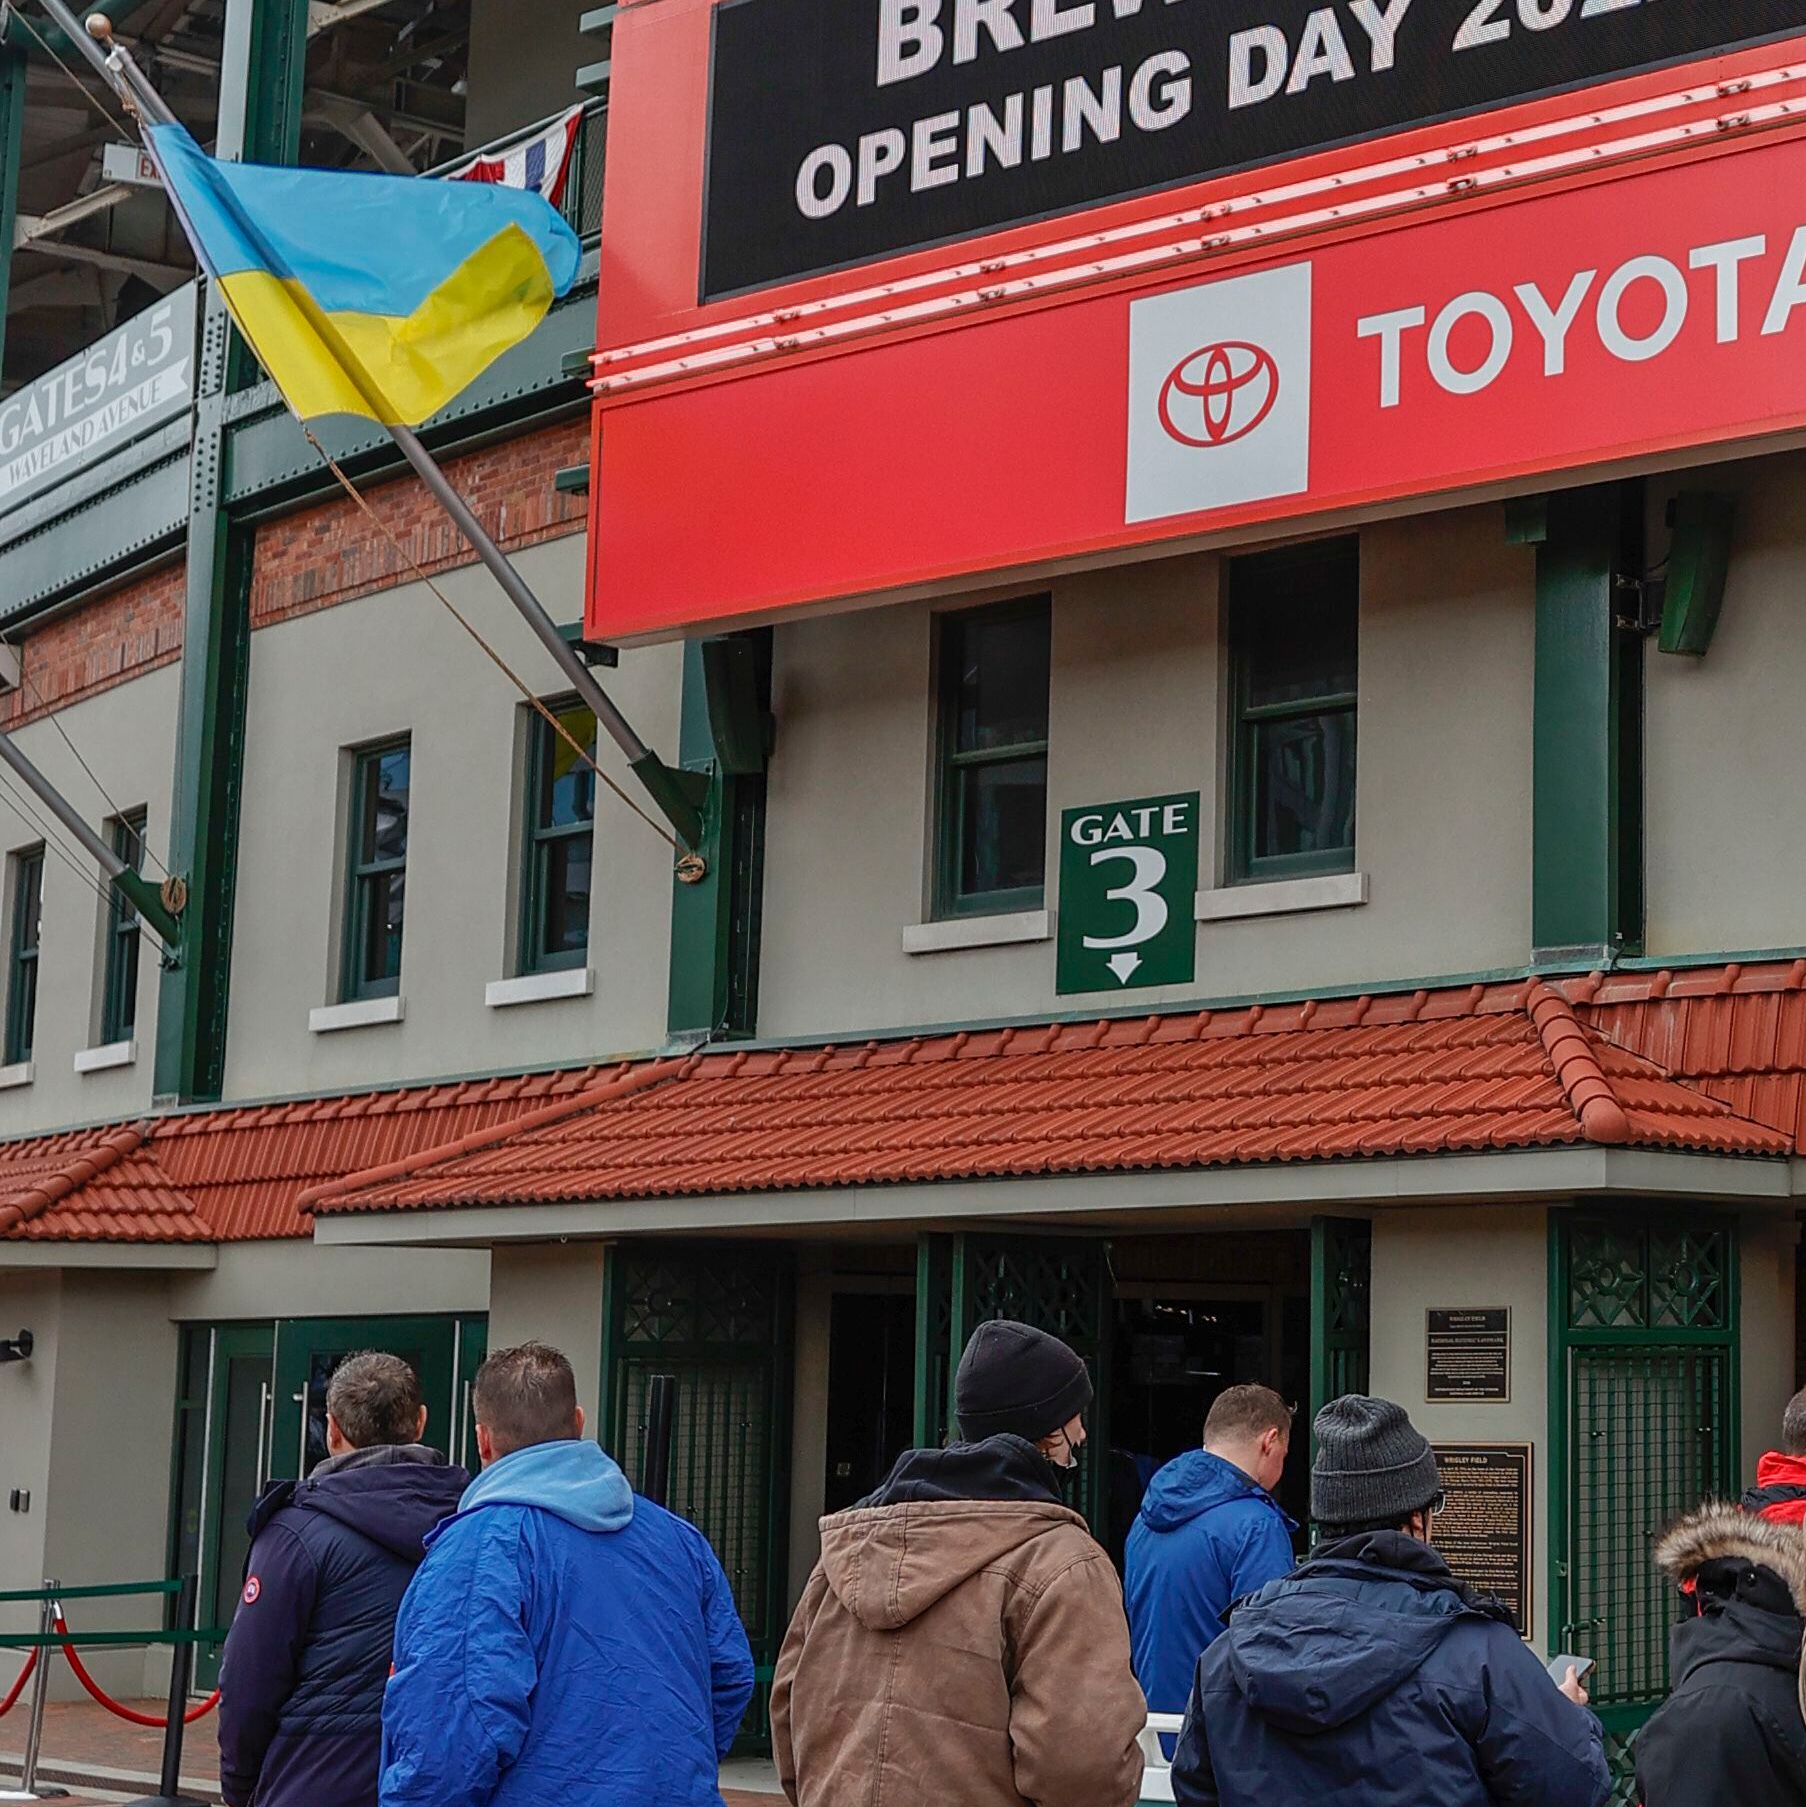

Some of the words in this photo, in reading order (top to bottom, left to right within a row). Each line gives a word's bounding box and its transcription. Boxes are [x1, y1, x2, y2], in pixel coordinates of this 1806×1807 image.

[794, 49, 1193, 219] OPENING
[0, 348, 107, 456] GATES
[107, 332, 128, 387] 4
[131, 338, 146, 368] &
[147, 303, 173, 367] 5
[9, 419, 95, 486] WAVELAND
[96, 374, 162, 436] AVENUE
[1070, 802, 1189, 845] GATE
[1082, 845, 1169, 950] 3
